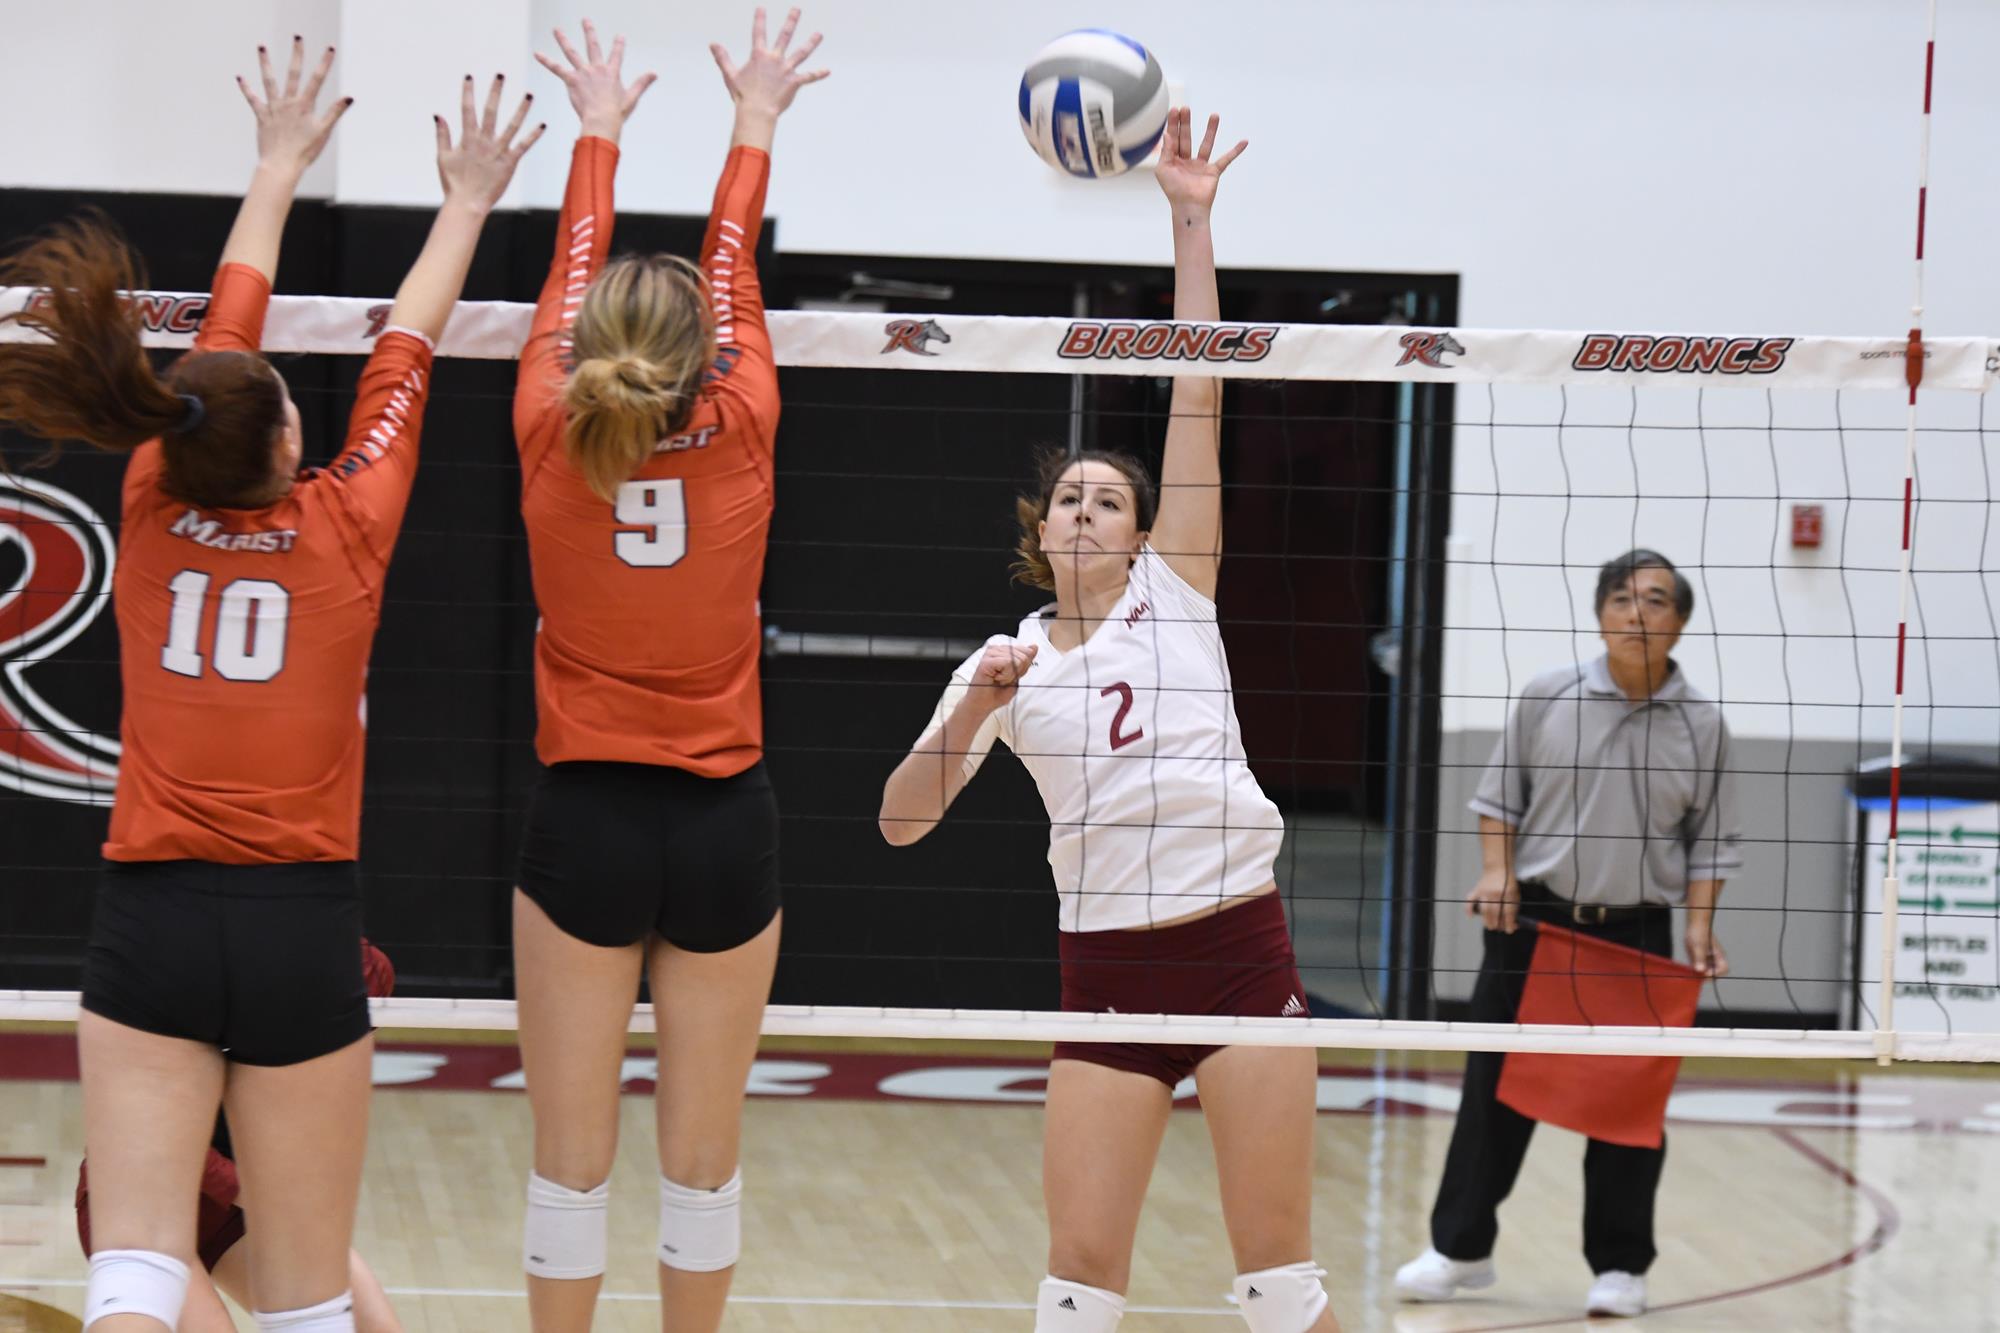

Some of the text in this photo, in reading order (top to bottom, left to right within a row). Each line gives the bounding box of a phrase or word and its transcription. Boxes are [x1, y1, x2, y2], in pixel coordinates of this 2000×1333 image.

[1058, 322, 1279, 361] BRONCS
[1572, 334, 1795, 374] BRONCS
[168, 509, 298, 553] MARIST
[613, 478, 687, 567] 9
[160, 568, 291, 682] 10
[1100, 681, 1144, 751] 2
